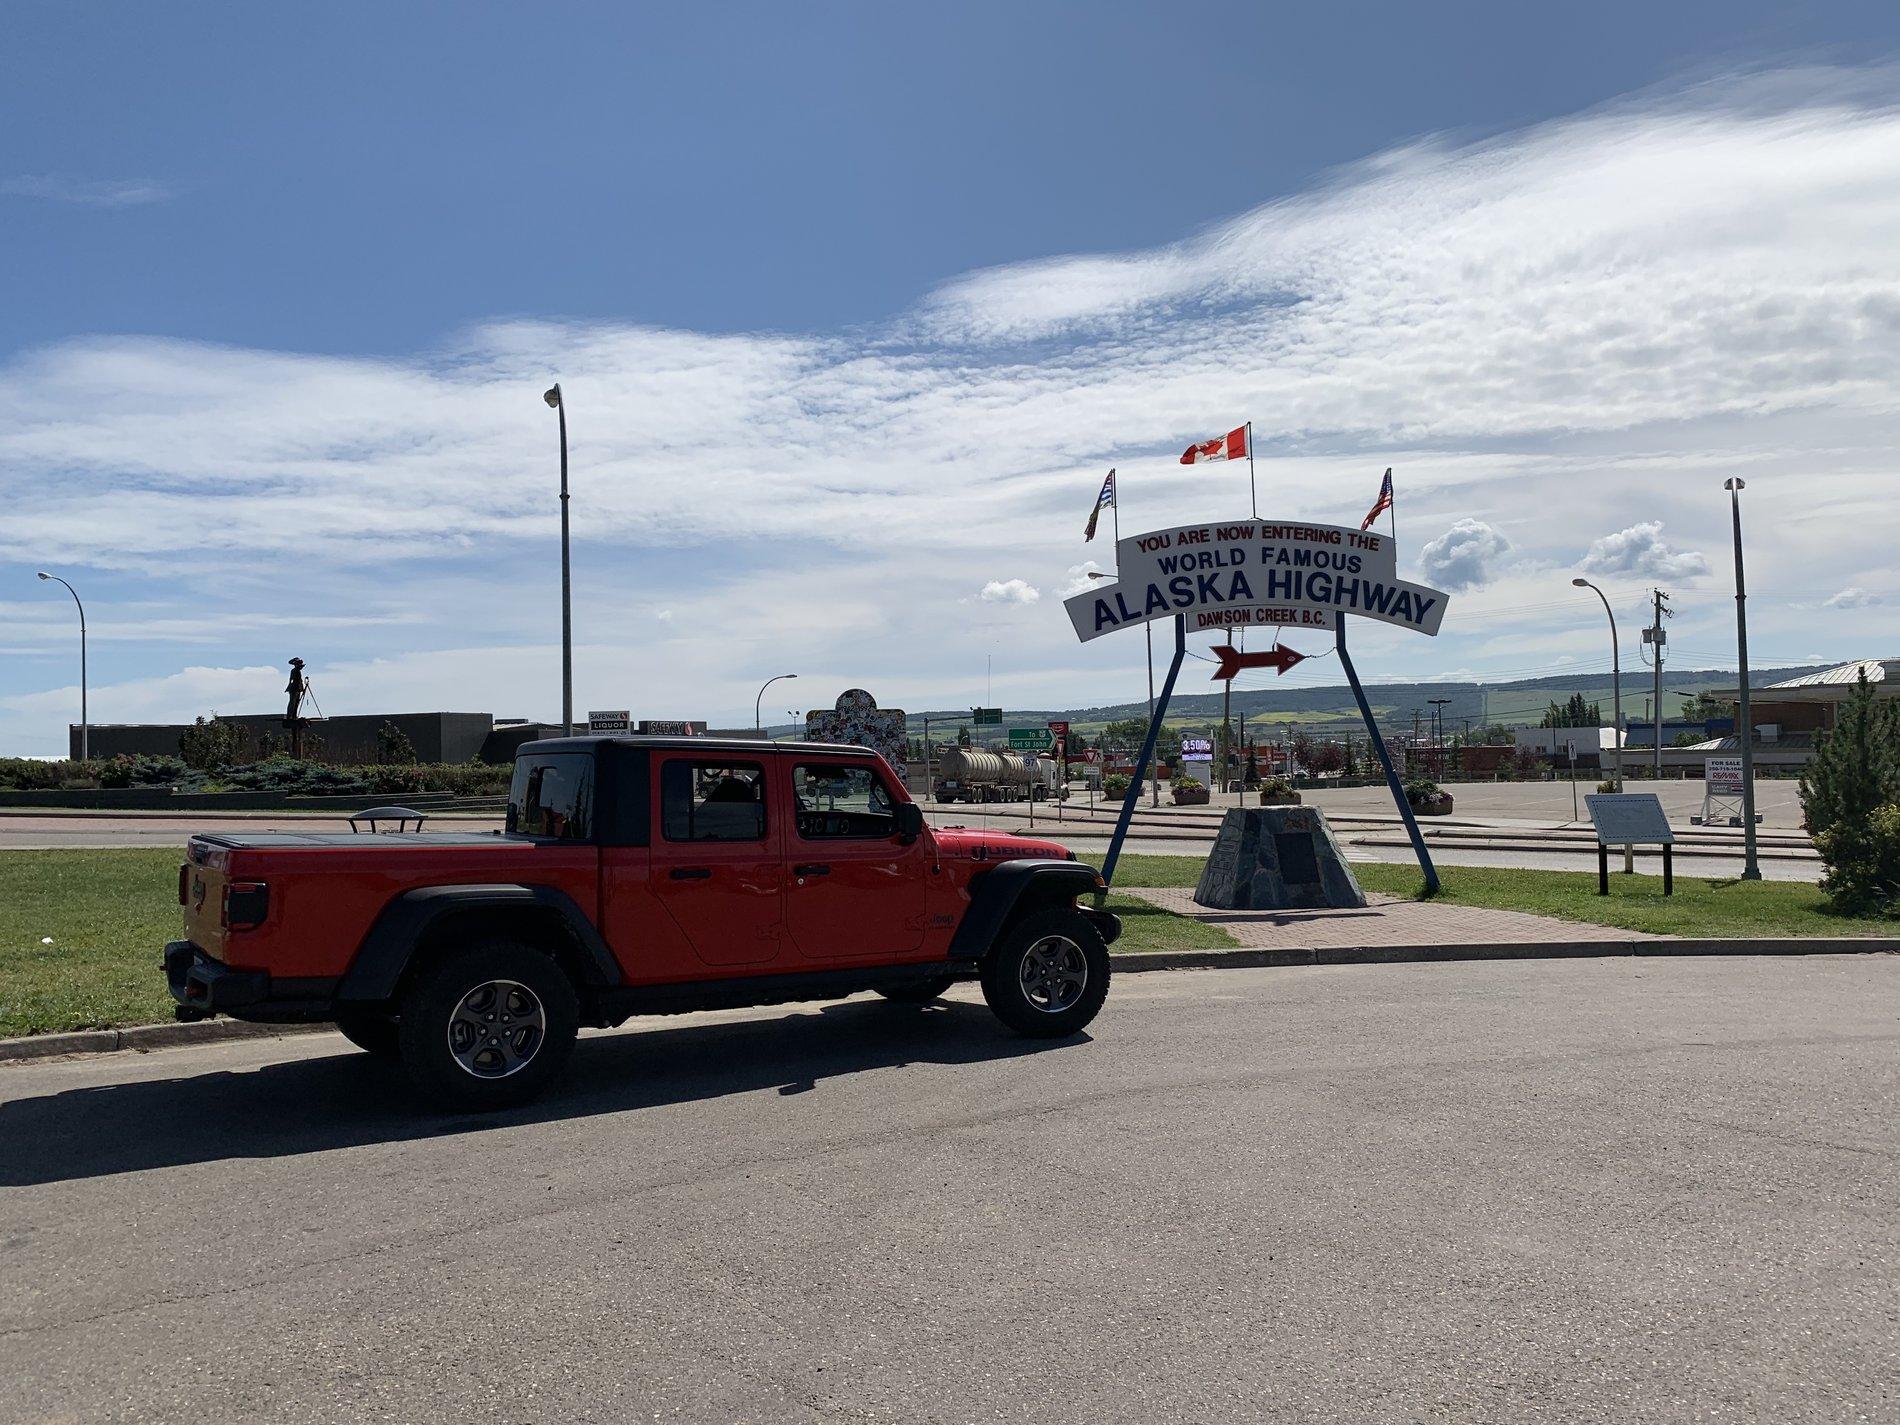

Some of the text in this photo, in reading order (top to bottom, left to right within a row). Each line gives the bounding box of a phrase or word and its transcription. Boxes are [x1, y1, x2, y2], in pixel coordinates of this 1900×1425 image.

[1136, 525, 1380, 553] YOU ARE NOW ENTERING THE
[1157, 546, 1362, 575] WORLD FAMOUS
[1095, 569, 1436, 631] ALASKA HIGHWAY
[1197, 607, 1326, 627] DAWSON CREEK B.C.
[650, 721, 683, 735] SAFEWAY
[1183, 740, 1210, 751] 3.50%
[1025, 758, 1035, 767] 97
